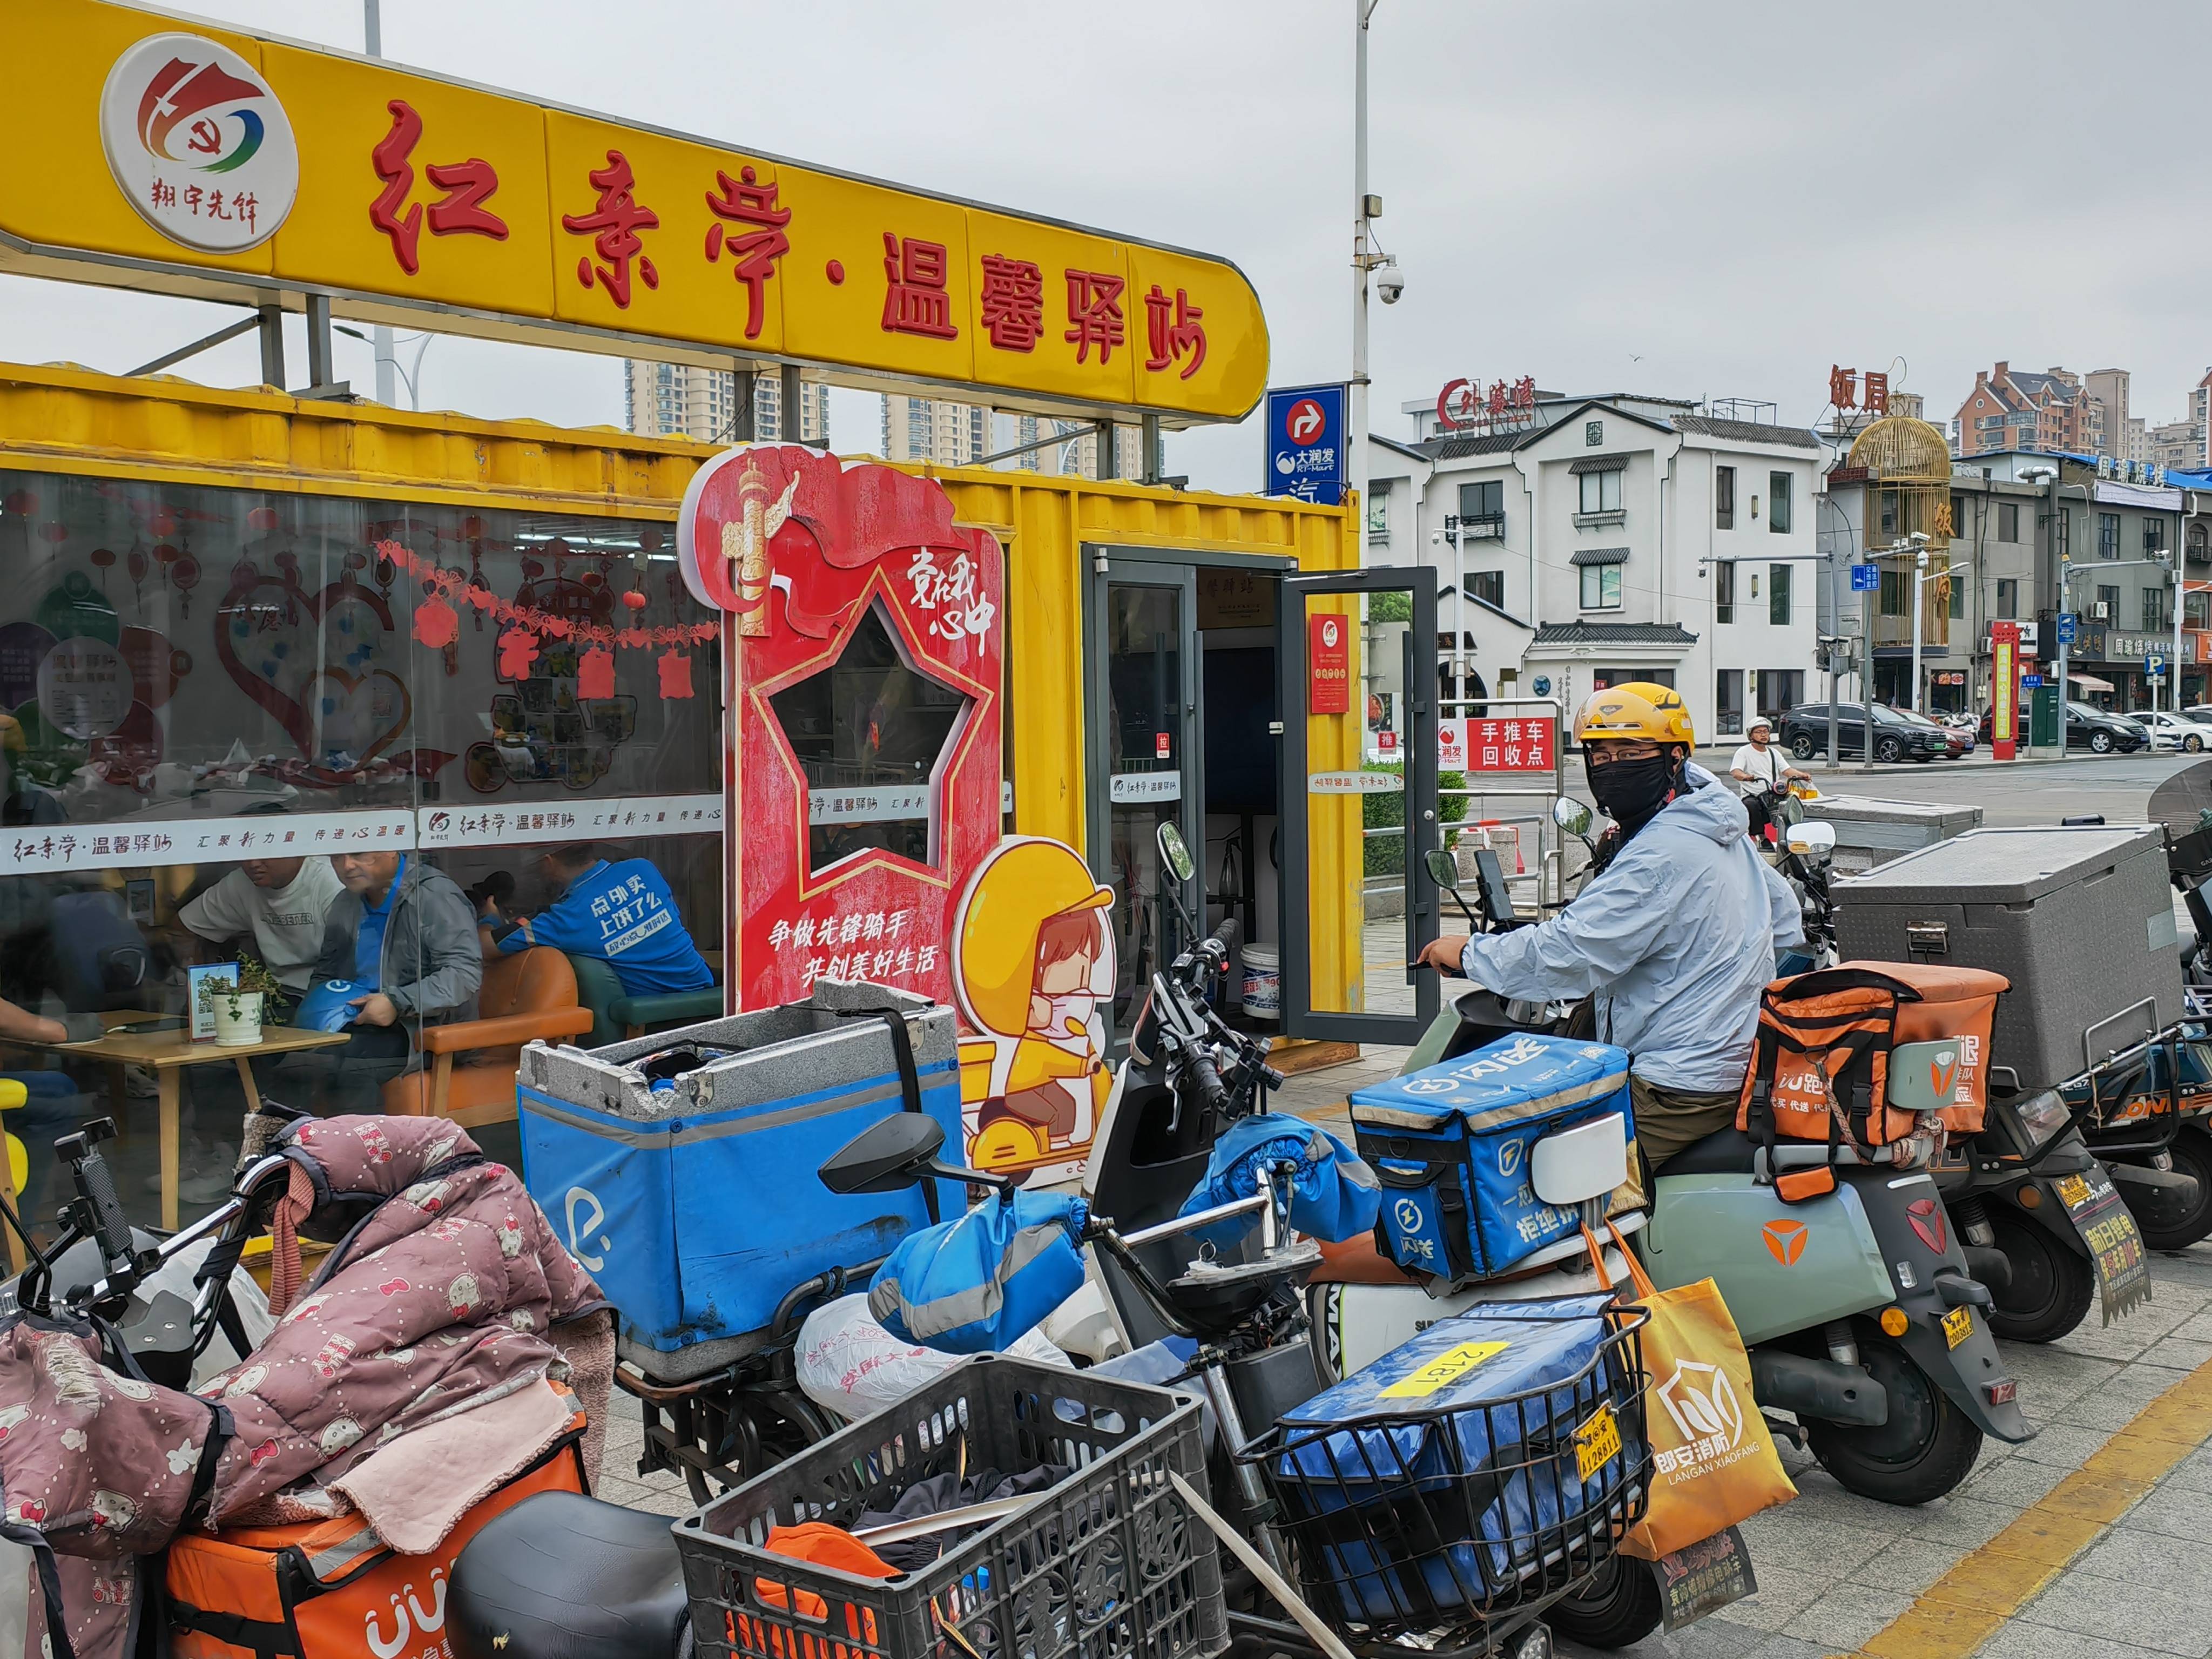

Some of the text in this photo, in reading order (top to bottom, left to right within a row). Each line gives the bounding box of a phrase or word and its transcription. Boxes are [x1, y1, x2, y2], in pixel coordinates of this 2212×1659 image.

[1830, 365, 1889, 415] 饭局
[1297, 448, 1334, 464] 大润发
[1297, 463, 1334, 473] RT-Mart
[2148, 657, 2162, 672] P
[1159, 736, 1168, 748] 拉
[1382, 735, 1392, 746] 推
[1481, 722, 1544, 742] 手推车
[1482, 745, 1545, 766] 回收点
[593, 811, 665, 826] 汇聚新力量
[197, 831, 296, 848] 汇聚新力量
[591, 874, 646, 918] 点外卖
[601, 892, 663, 940] 上饿了么
[768, 909, 910, 950] 争做先锋骑手
[801, 943, 940, 988] 共创美好生活
[1449, 1038, 1550, 1081] 闪送
[1790, 1100, 1809, 1112] 代送
[1401, 1236, 1434, 1259] 闪送
[1582, 1433, 1618, 1477] A128811
[1668, 1441, 1761, 1486] LANGAN XIAOFANG
